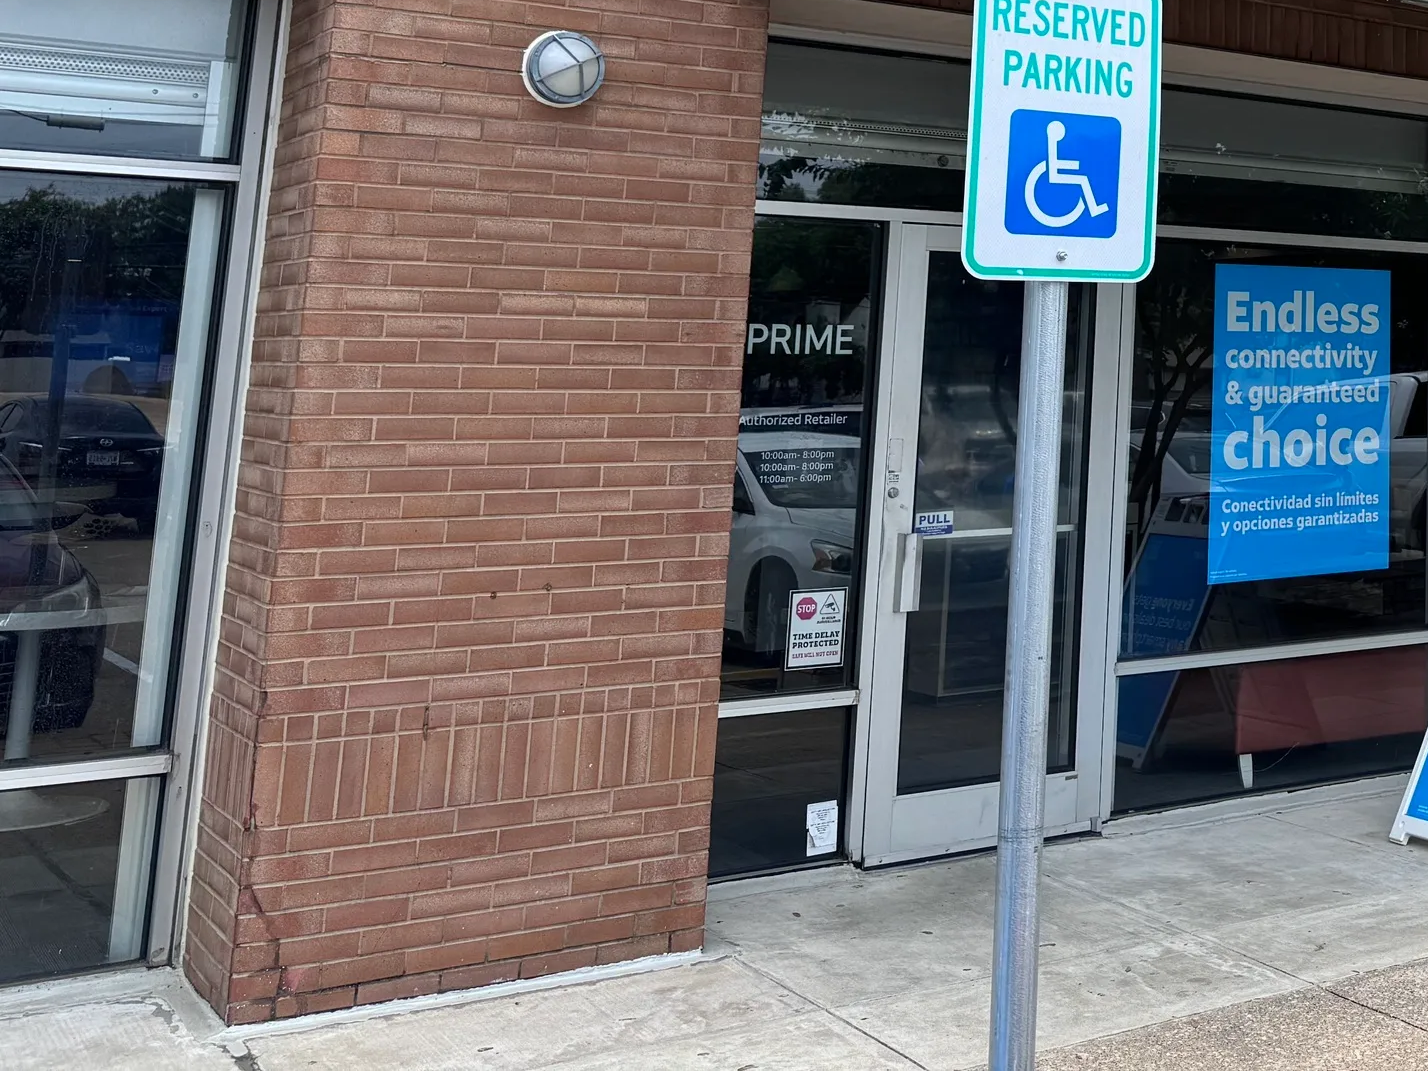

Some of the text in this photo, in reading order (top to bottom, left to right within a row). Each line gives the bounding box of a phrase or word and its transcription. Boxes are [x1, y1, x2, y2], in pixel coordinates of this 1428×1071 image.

[1003, 49, 1133, 98] PARKING
[1226, 290, 1380, 335] Endless
[747, 323, 855, 355] PRIME
[1225, 342, 1378, 376] connectivity
[1225, 379, 1380, 411] & guaranteed
[738, 413, 848, 426] Authorized Retailer
[1223, 413, 1380, 470] choice
[802, 450, 835, 460] 8:00pm
[801, 462, 834, 472] 8:00pm
[799, 474, 832, 484] 6:00pm
[1221, 491, 1380, 514] Conectividad sin límites
[919, 513, 951, 526] PULL
[1220, 509, 1379, 537] y opciones garantizadas
[797, 604, 816, 614] STOP
[792, 630, 841, 641] TIME DELAY
[792, 639, 839, 649] PROTECTED
